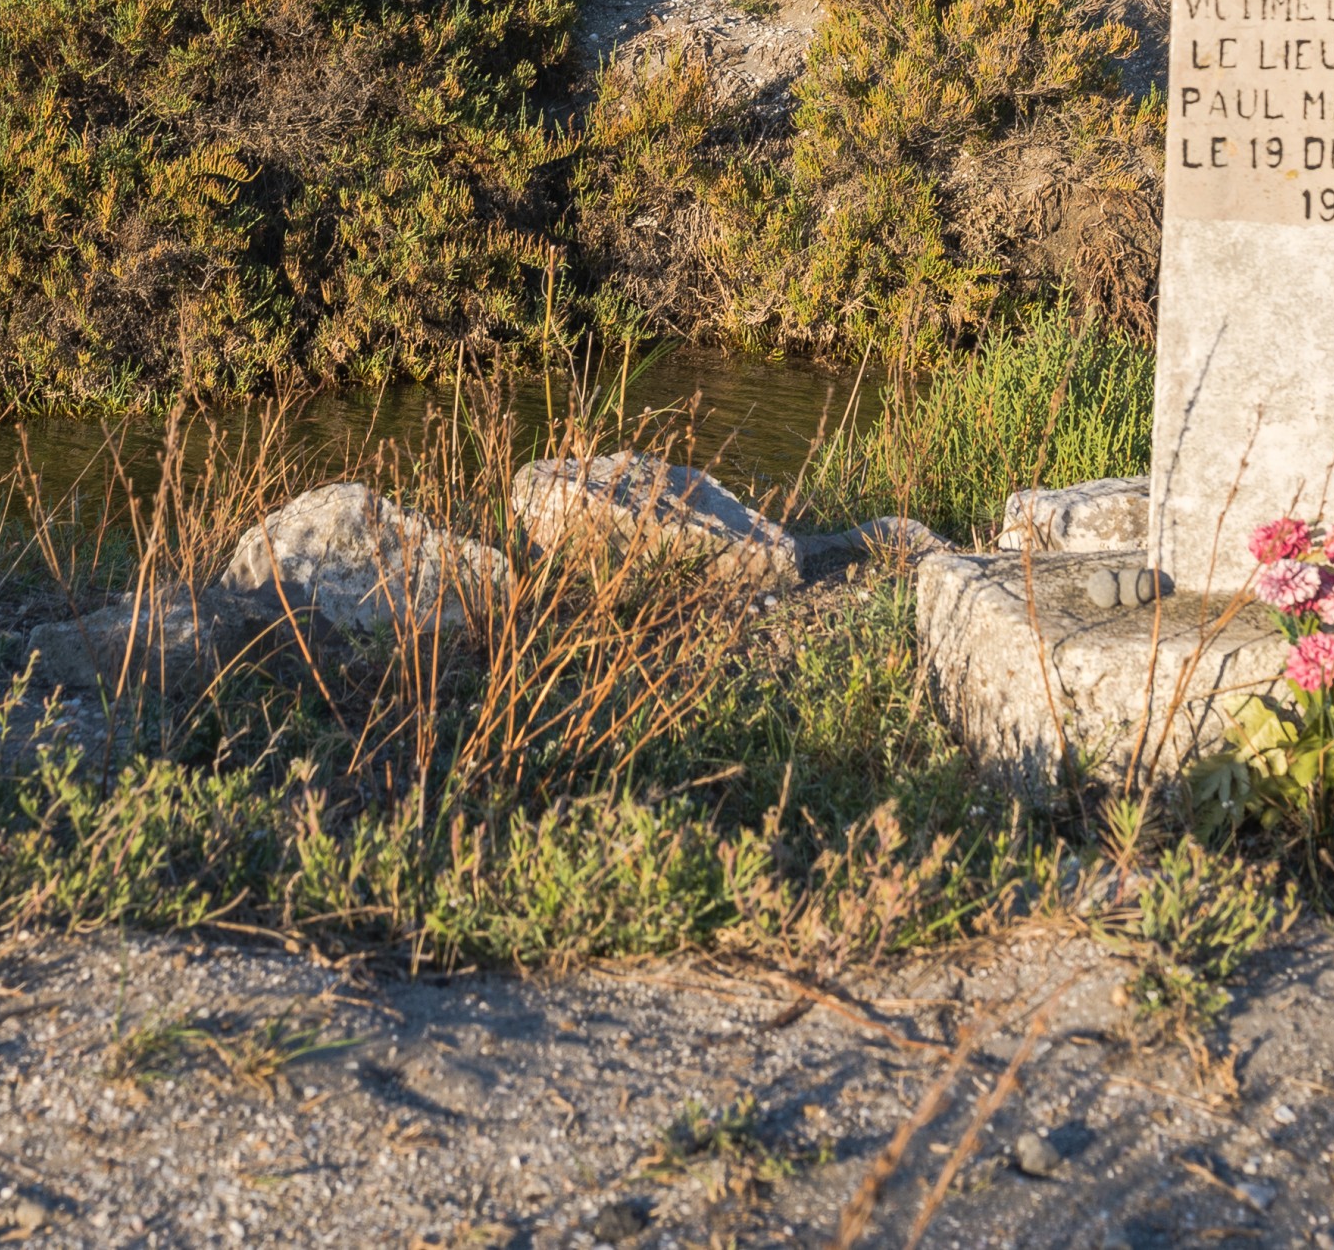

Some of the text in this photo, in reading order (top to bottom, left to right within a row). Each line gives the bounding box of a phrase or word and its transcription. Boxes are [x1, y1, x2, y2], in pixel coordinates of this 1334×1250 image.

[1192, 39, 1237, 70] LE
[1181, 87, 1284, 120] PAUL
[1181, 137, 1228, 169] LE
[1250, 137, 1284, 169] 19
